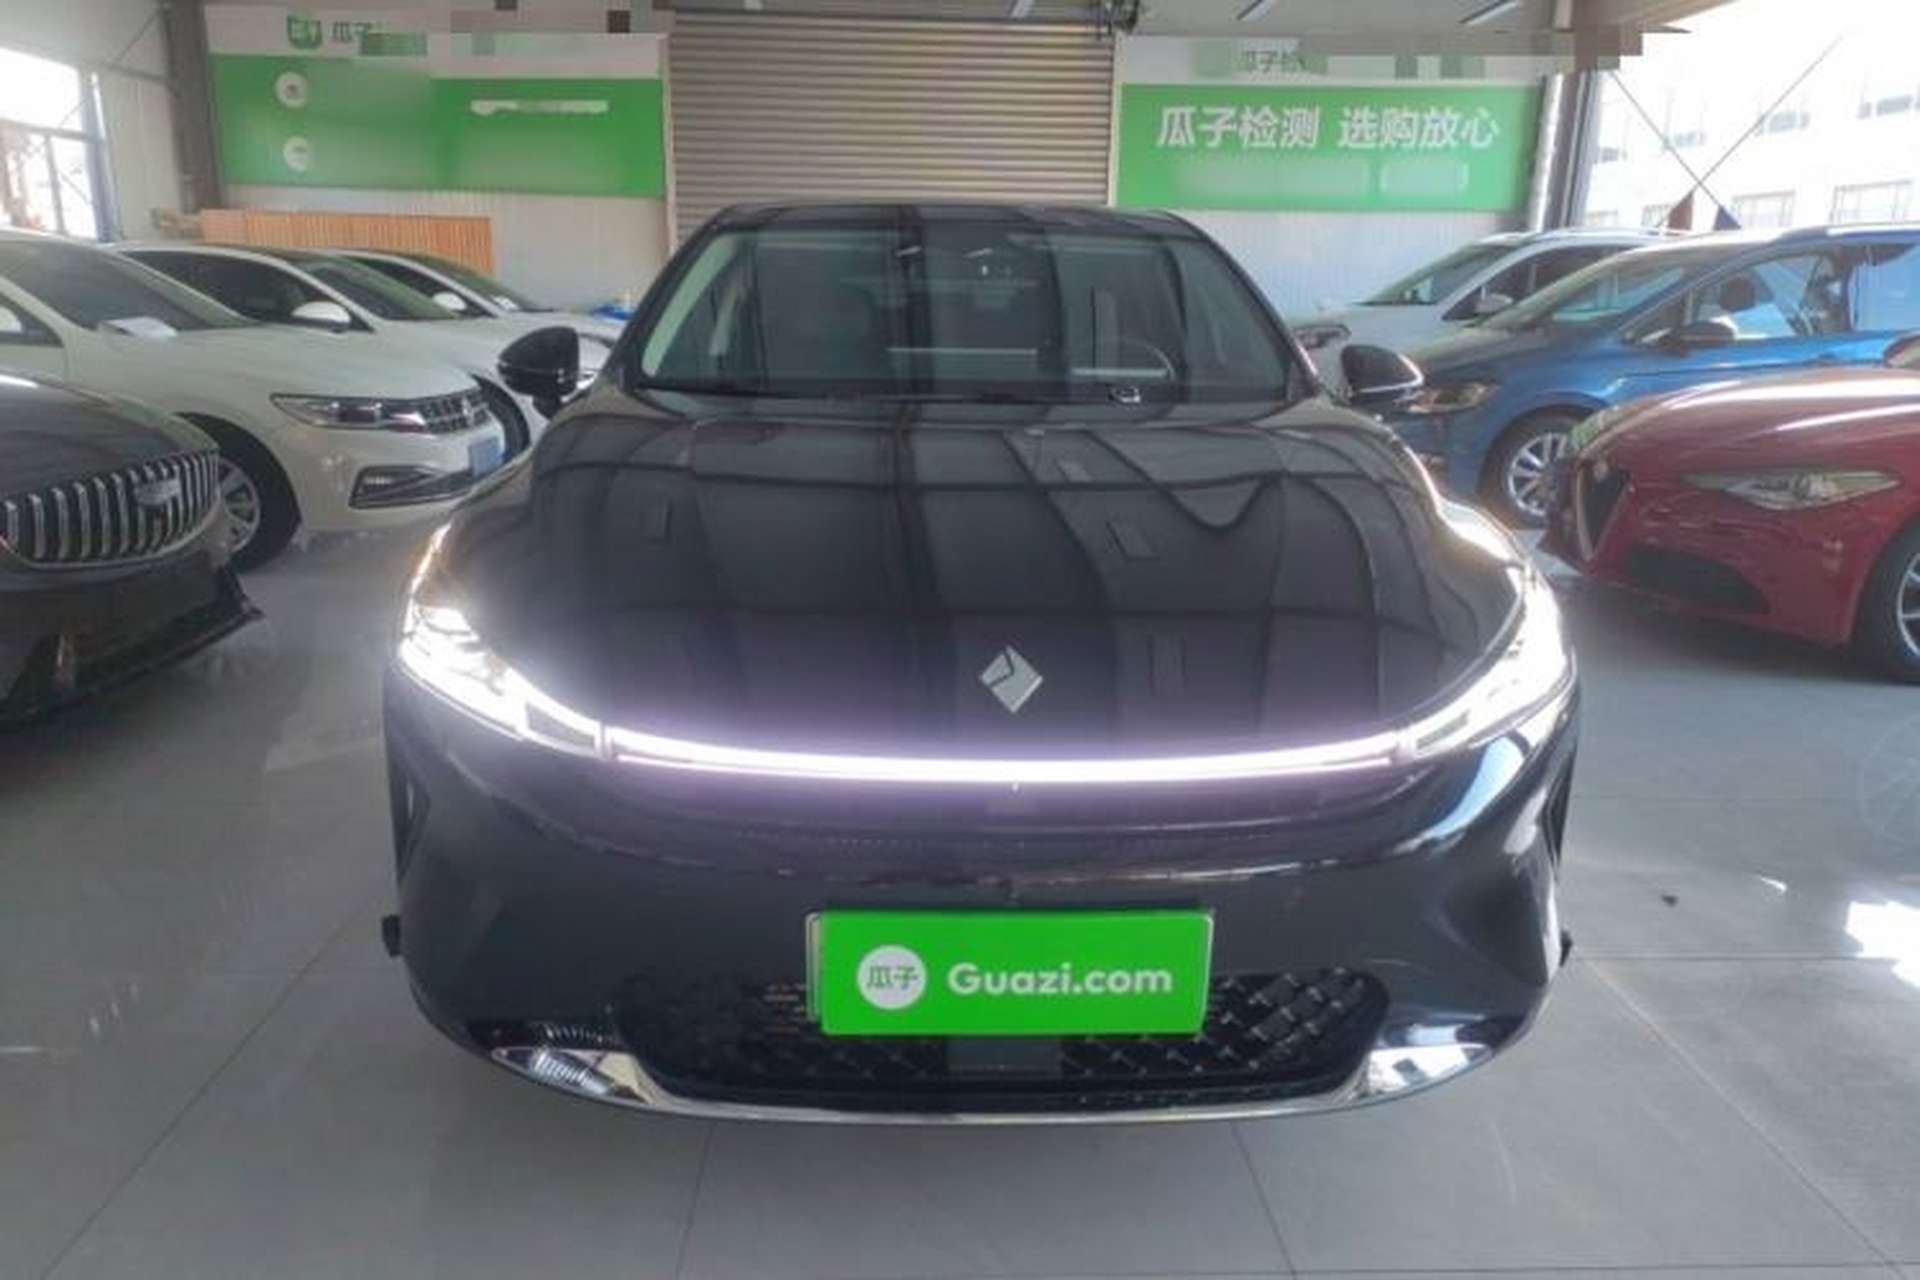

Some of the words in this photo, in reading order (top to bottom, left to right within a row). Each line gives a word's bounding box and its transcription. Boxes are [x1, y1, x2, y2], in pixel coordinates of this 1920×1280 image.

[1157, 104, 1320, 151] 瓜子检测
[1339, 106, 1499, 151] 选购放心
[865, 965, 919, 992] 瓜子
[947, 961, 1173, 996] Guazi.com
